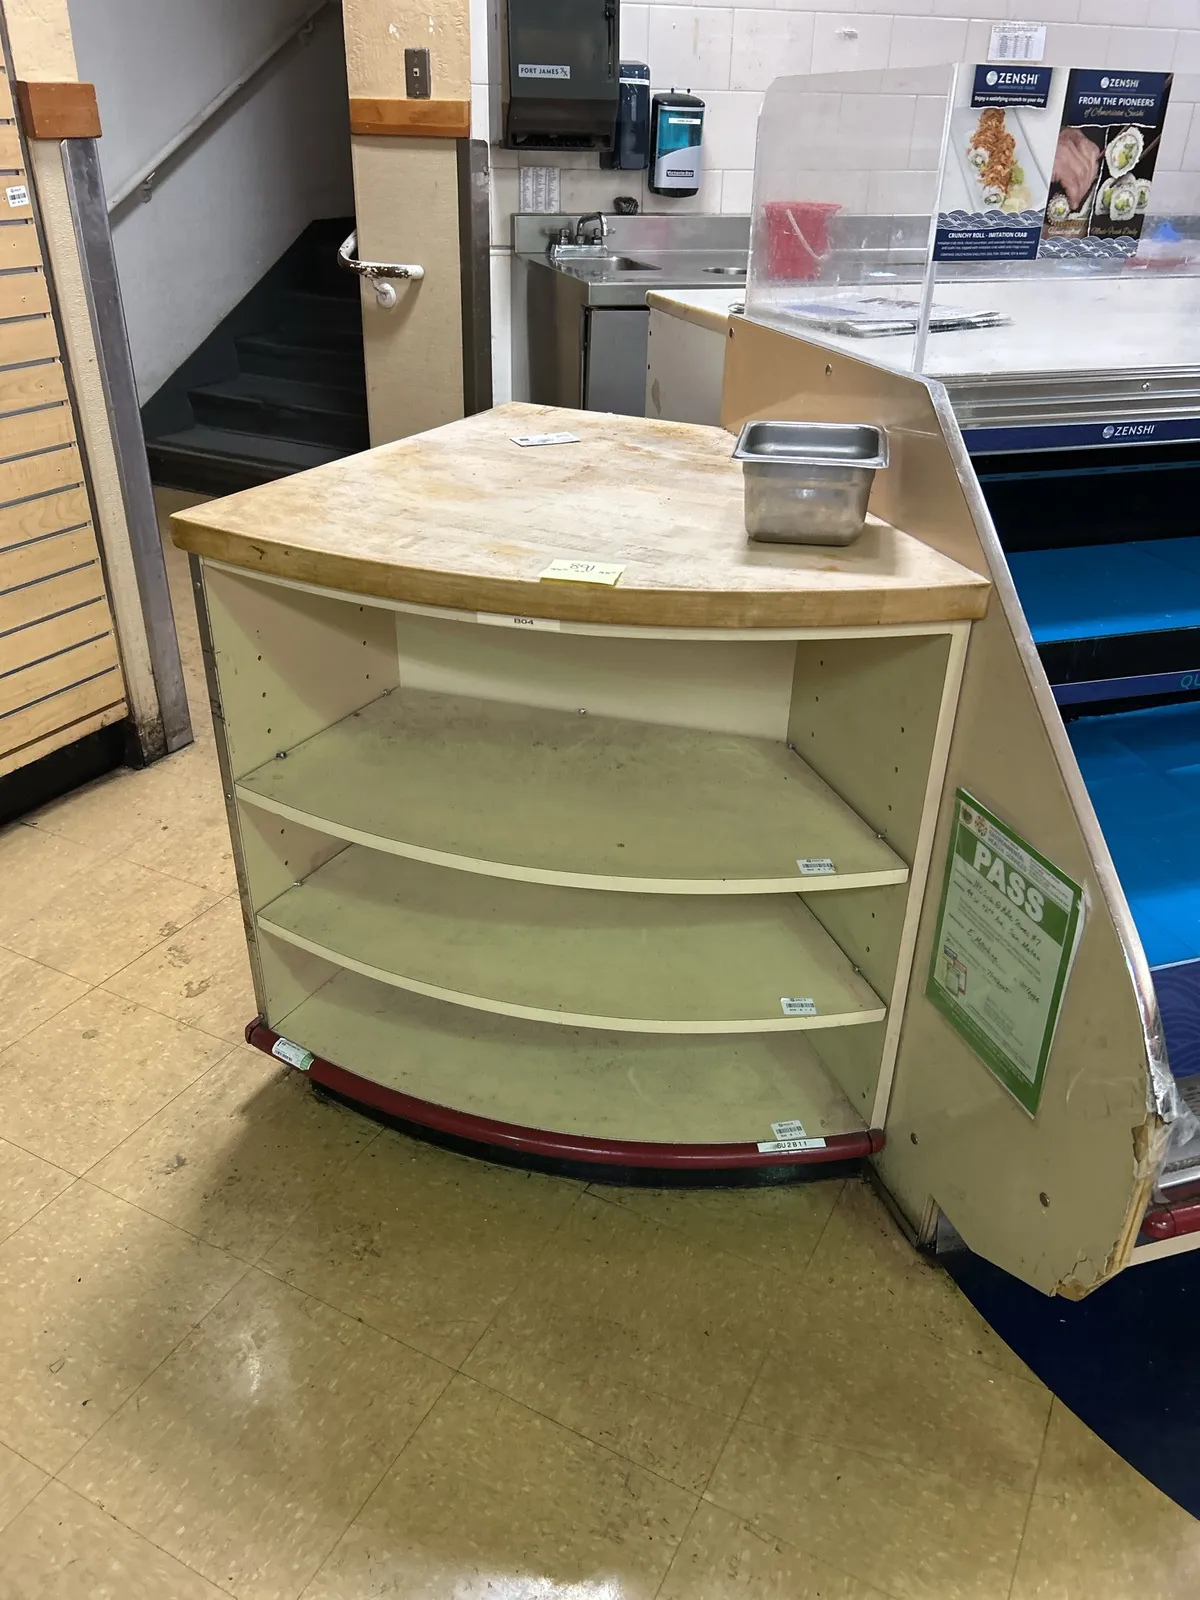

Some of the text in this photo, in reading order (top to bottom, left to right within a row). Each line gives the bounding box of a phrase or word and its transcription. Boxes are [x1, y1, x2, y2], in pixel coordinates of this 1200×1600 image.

[997, 72, 1038, 85] ZENSHI
[1109, 78, 1140, 88] ZENSHI
[1078, 96, 1155, 107] FROM THE PIONEERS
[1114, 424, 1155, 436] ZENSHI
[973, 840, 1045, 922] PASS
